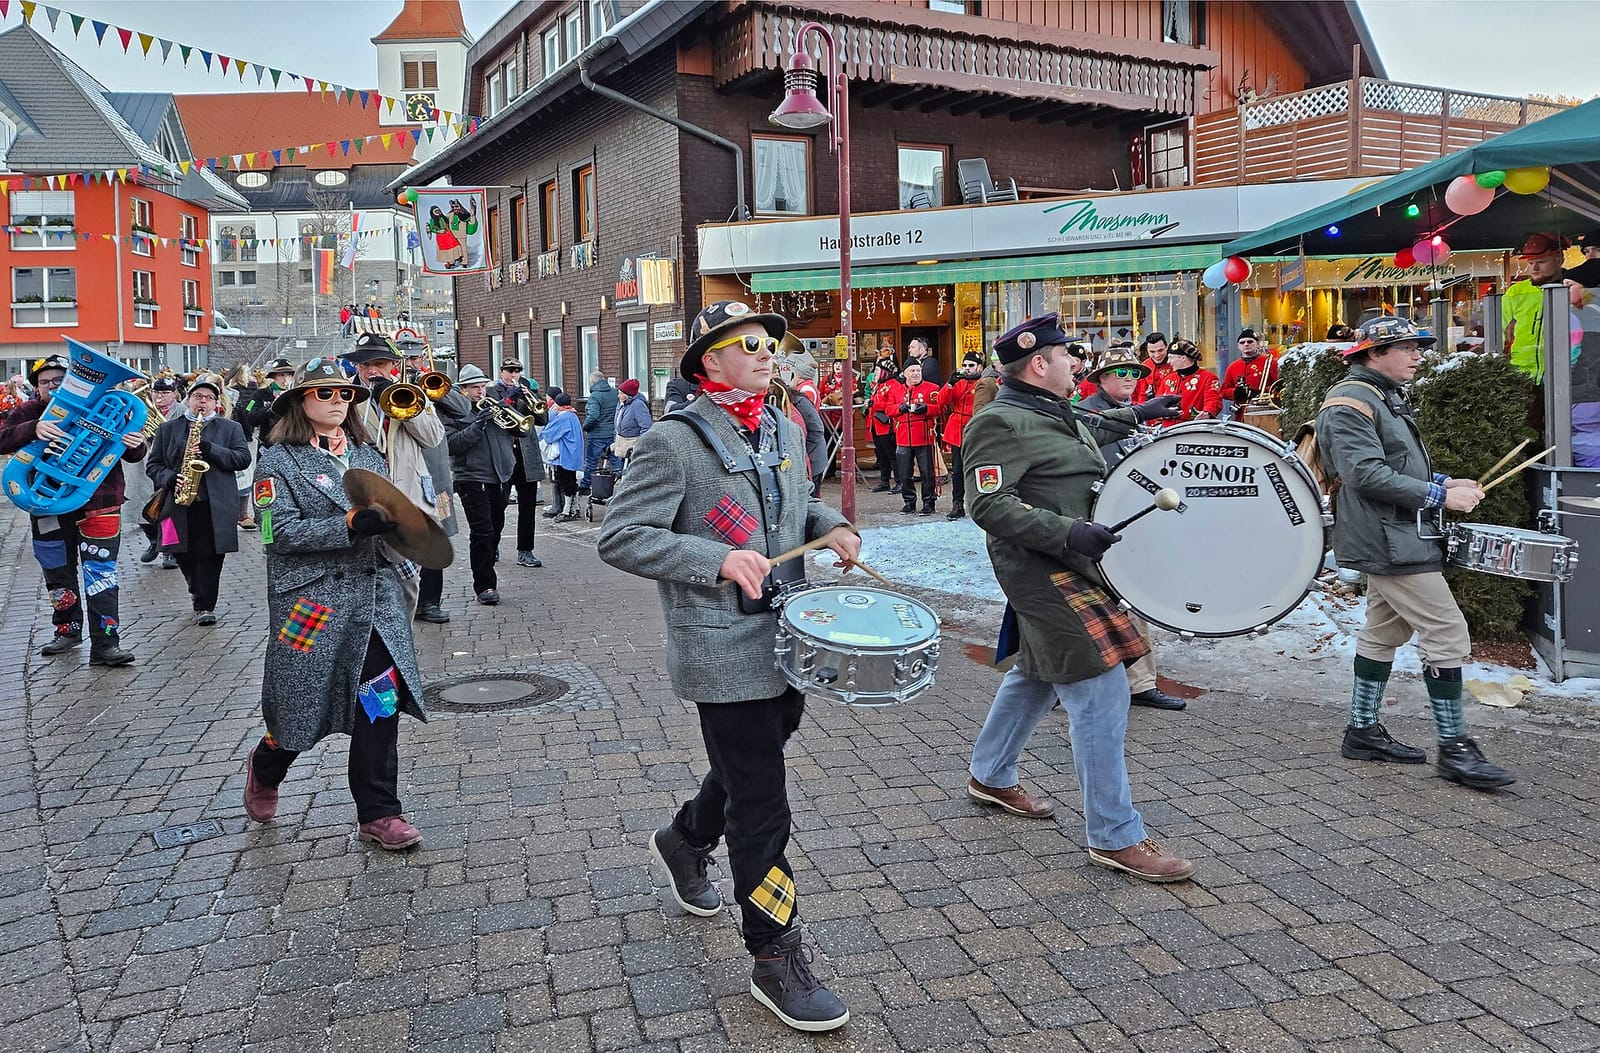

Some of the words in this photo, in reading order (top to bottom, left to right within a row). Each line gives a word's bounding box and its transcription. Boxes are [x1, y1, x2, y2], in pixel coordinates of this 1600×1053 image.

[1042, 200, 1169, 234] Moosmann
[820, 231, 901, 251] Hatstraße
[906, 229, 923, 244] 12
[615, 279, 640, 300] MOOS
[655, 330, 675, 339] EINGANG
